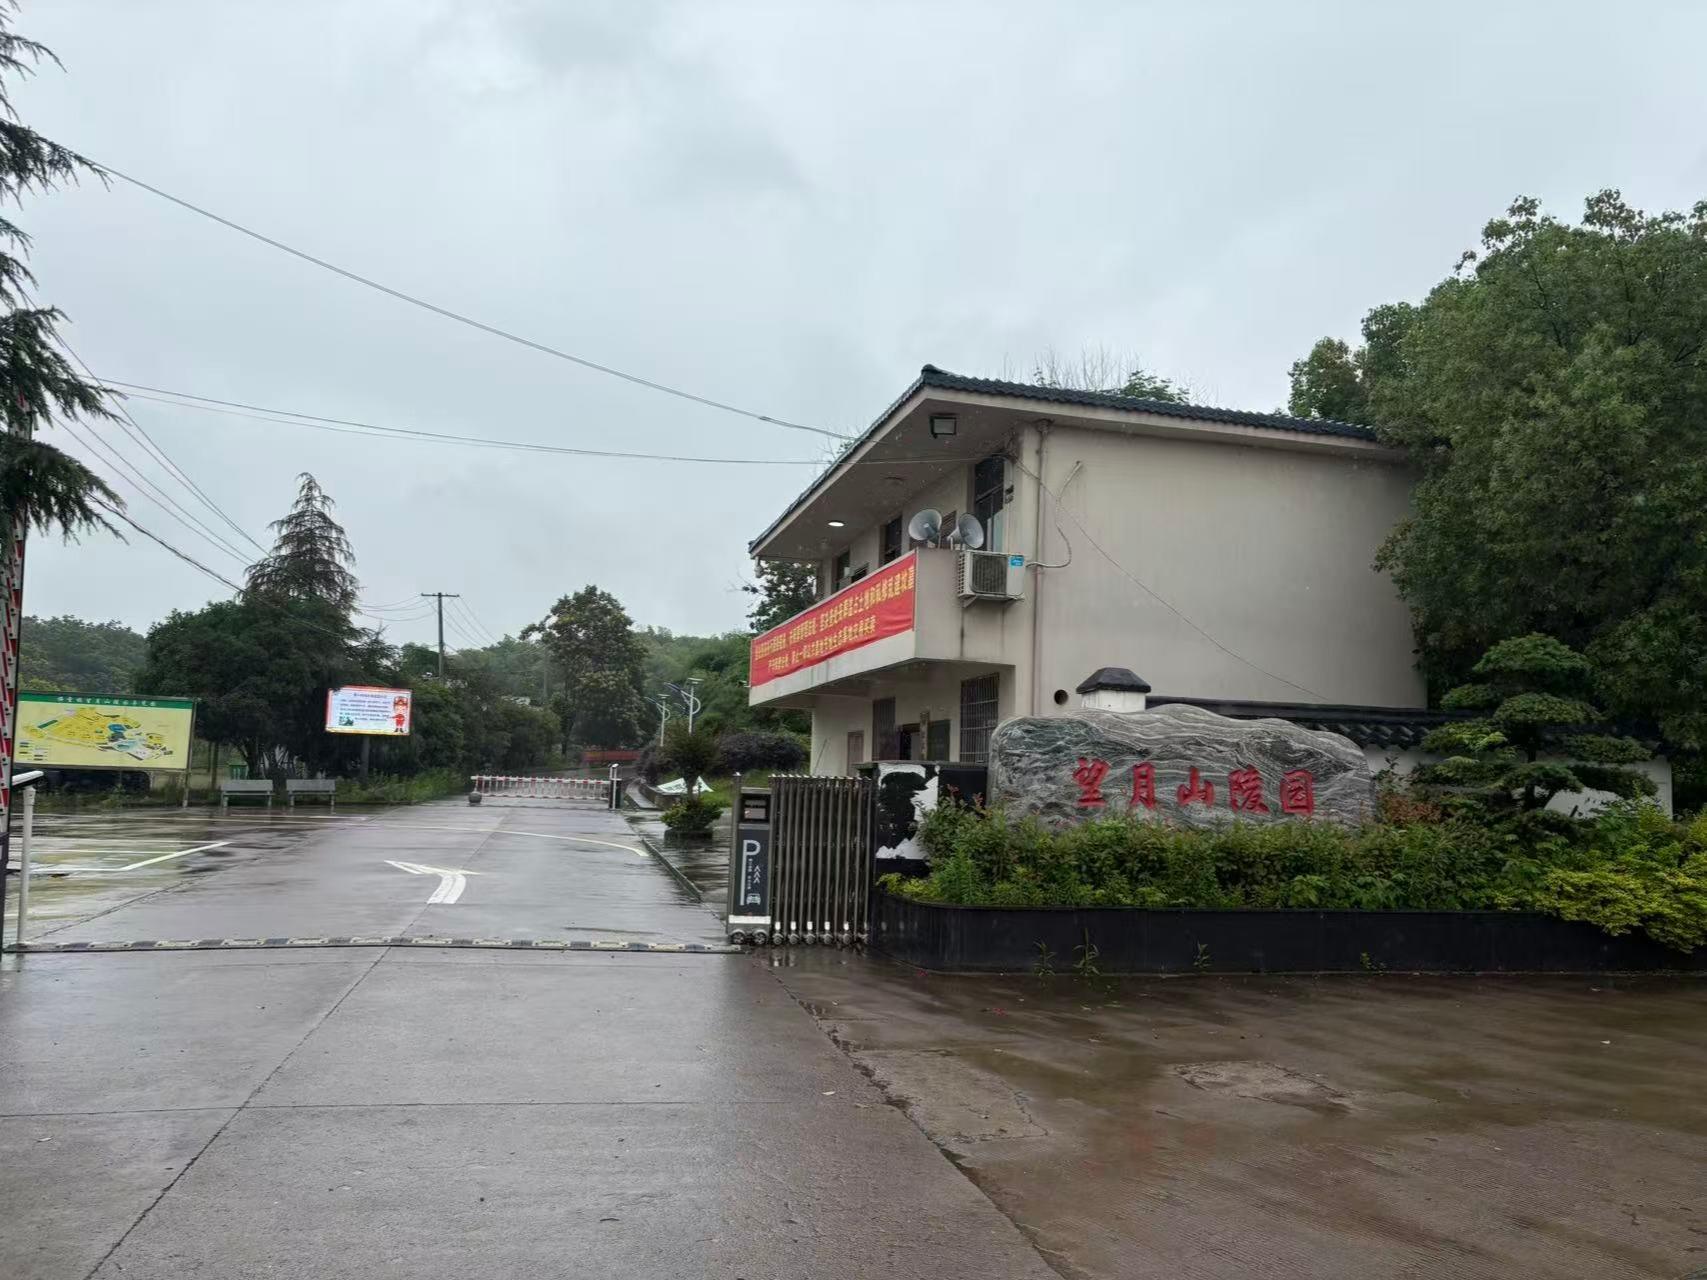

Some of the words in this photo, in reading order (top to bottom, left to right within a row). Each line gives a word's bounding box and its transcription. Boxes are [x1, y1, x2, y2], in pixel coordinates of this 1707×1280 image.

[1073, 757, 1314, 815] 望月山陵园
[740, 840, 761, 906] P
